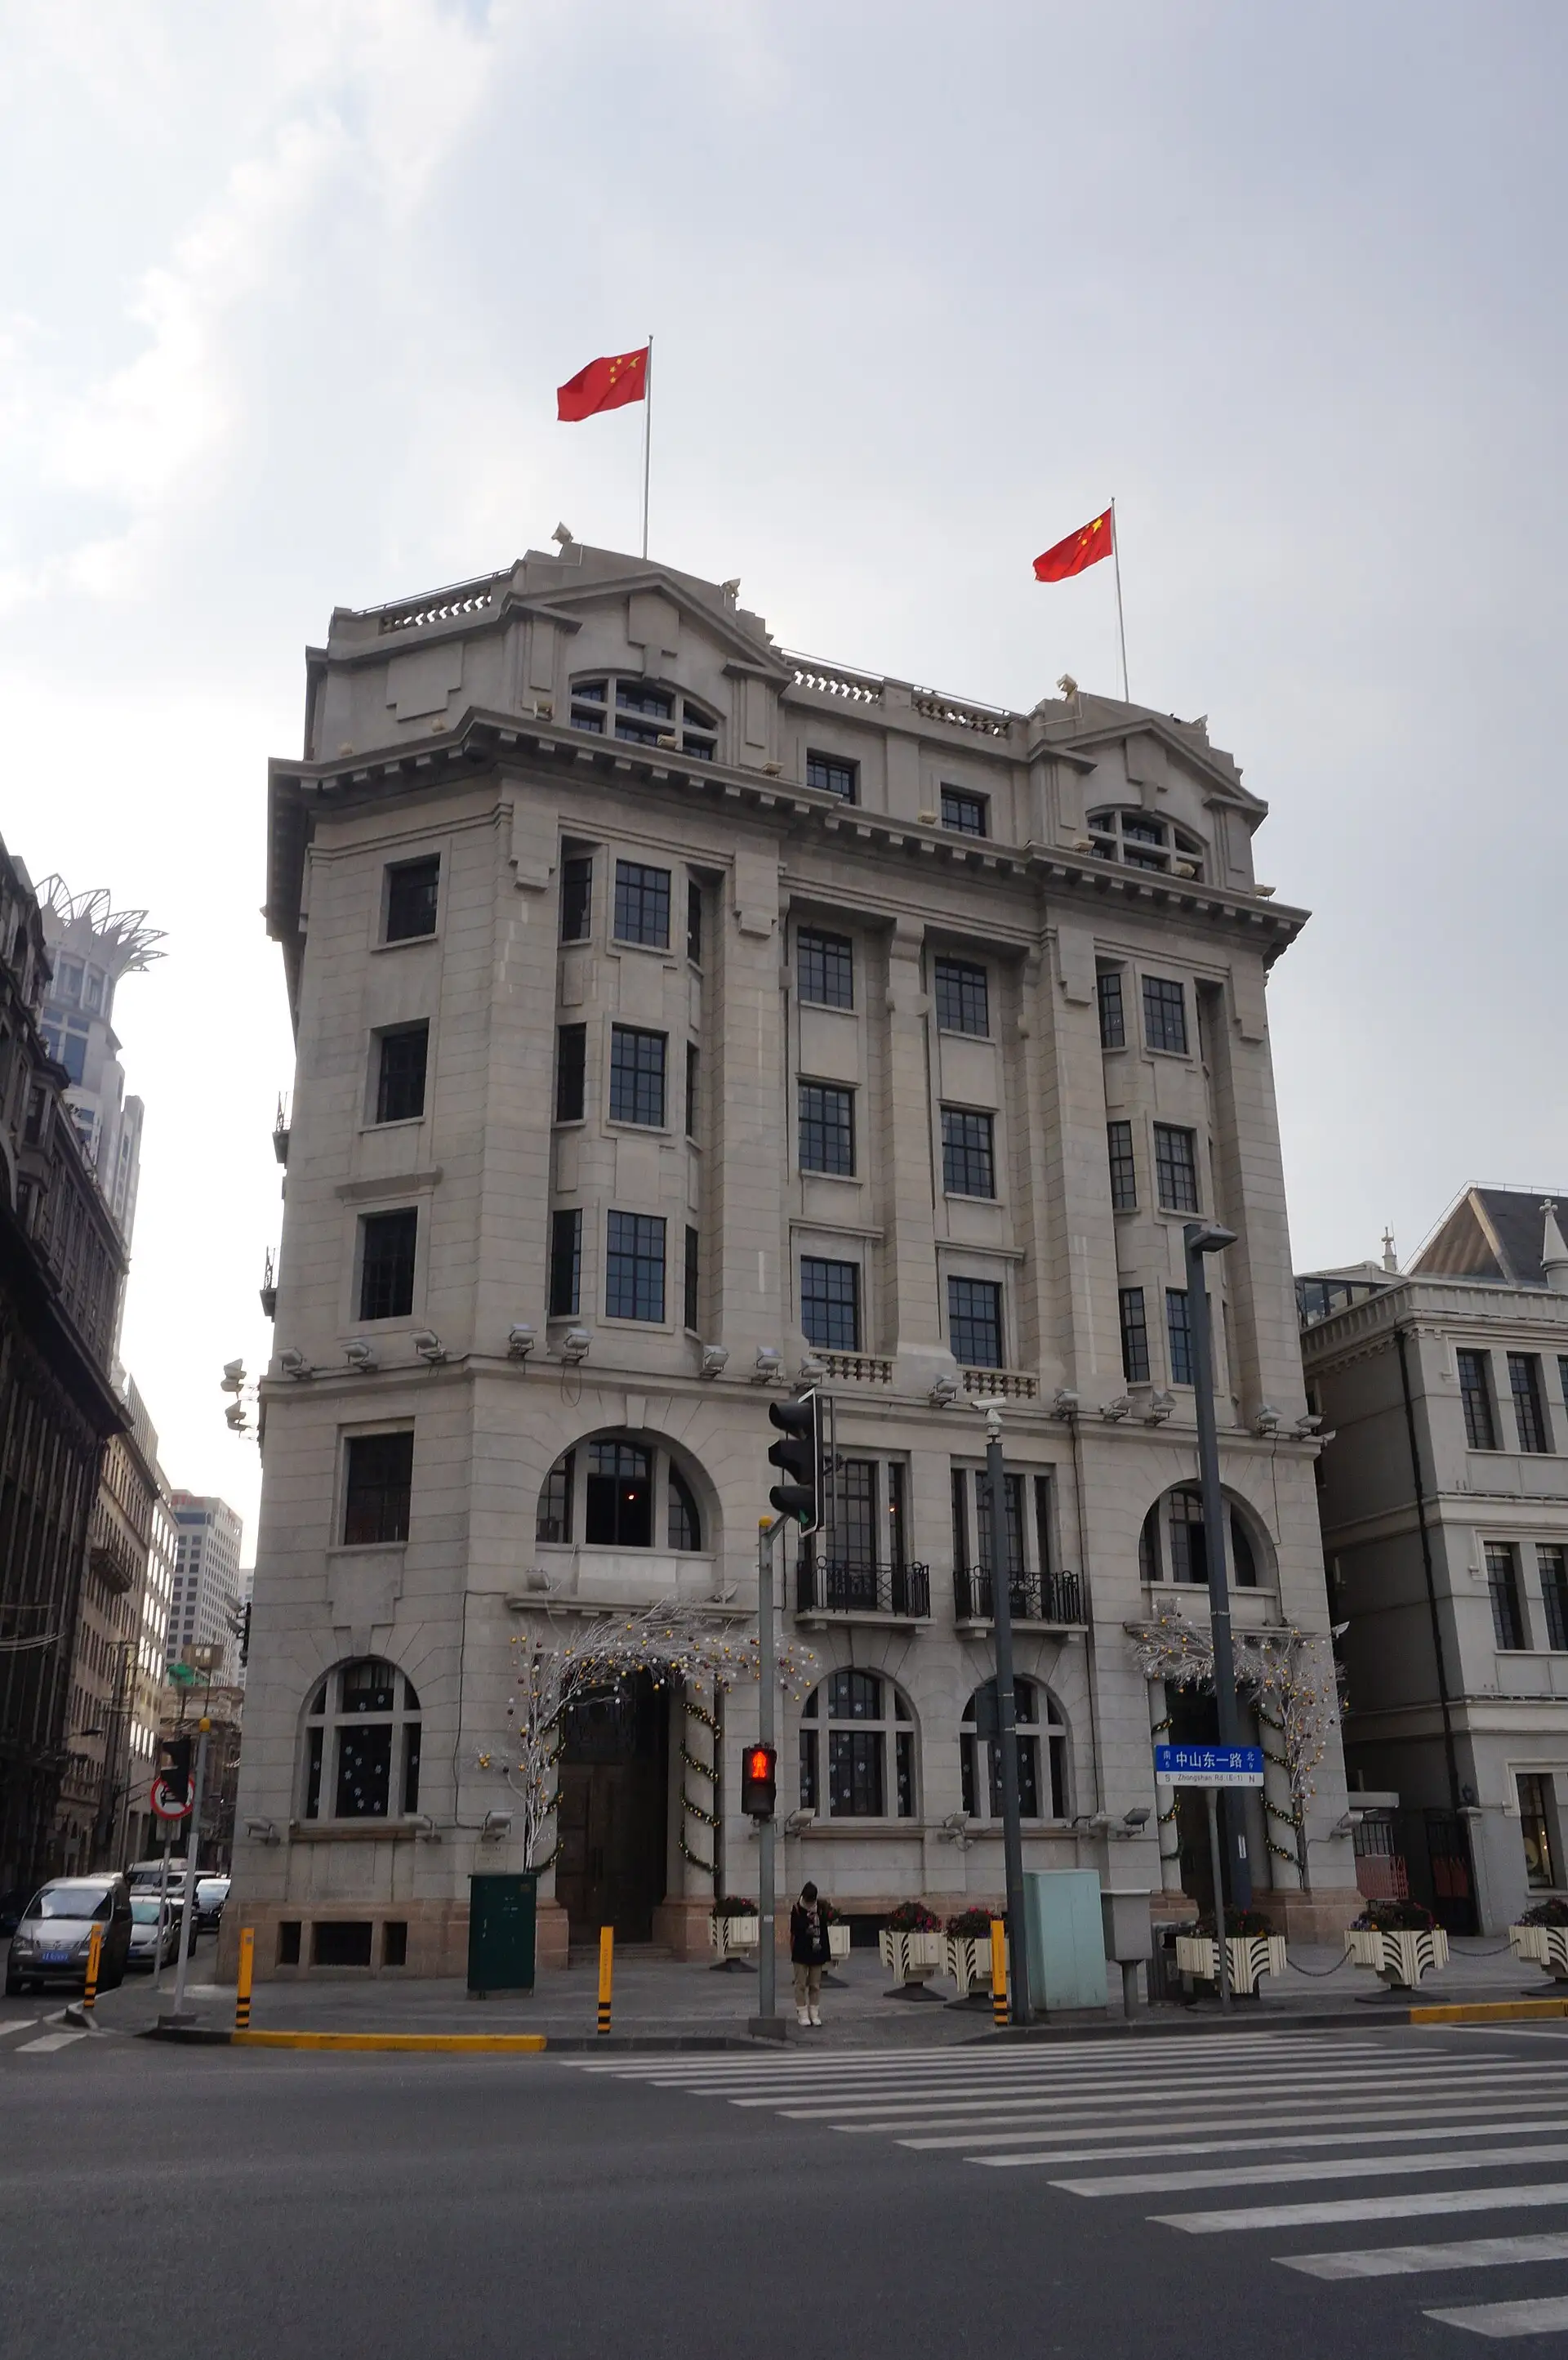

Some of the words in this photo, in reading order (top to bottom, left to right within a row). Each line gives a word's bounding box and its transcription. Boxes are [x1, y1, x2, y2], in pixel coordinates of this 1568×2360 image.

[1164, 1750, 1170, 1760] 南
[1176, 1751, 1242, 1768] 中山东一路
[1246, 1751, 1254, 1761] 北
[1177, 1773, 1213, 1782] Zhongshan
[1249, 1774, 1255, 1782] N
